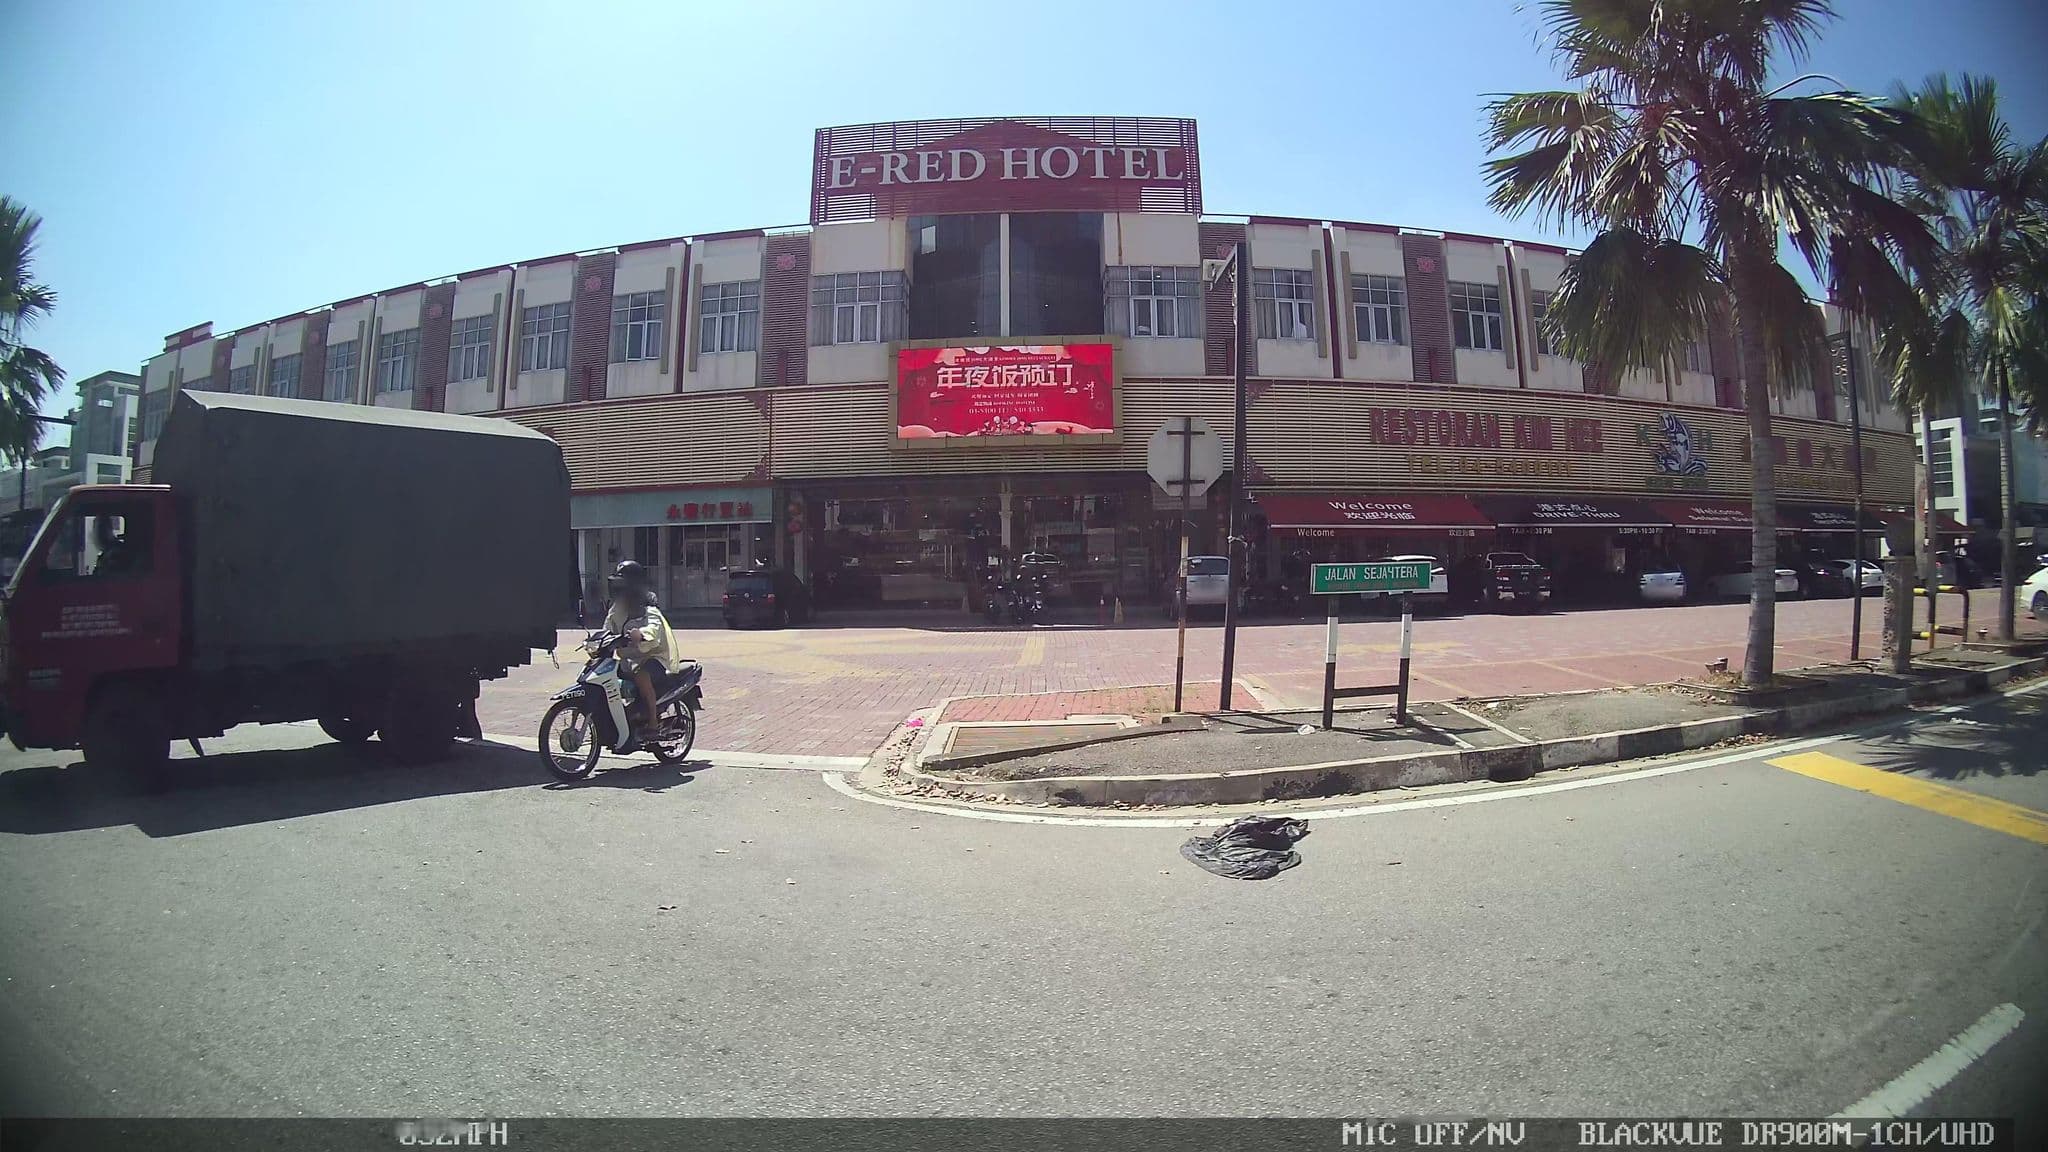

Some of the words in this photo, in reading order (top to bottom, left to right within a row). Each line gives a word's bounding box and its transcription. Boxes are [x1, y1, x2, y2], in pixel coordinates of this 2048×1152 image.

[826, 149, 987, 189] E-RED
[999, 146, 1184, 182] HOTEL
[936, 363, 1073, 389] 年夜饭预订
[1369, 408, 1501, 448] RESTORAN
[1329, 501, 1413, 511] Welcome
[1533, 511, 1621, 519] DRIVE-THRU
[1297, 527, 1335, 537] Welcome
[1324, 567, 1357, 582] JALAN
